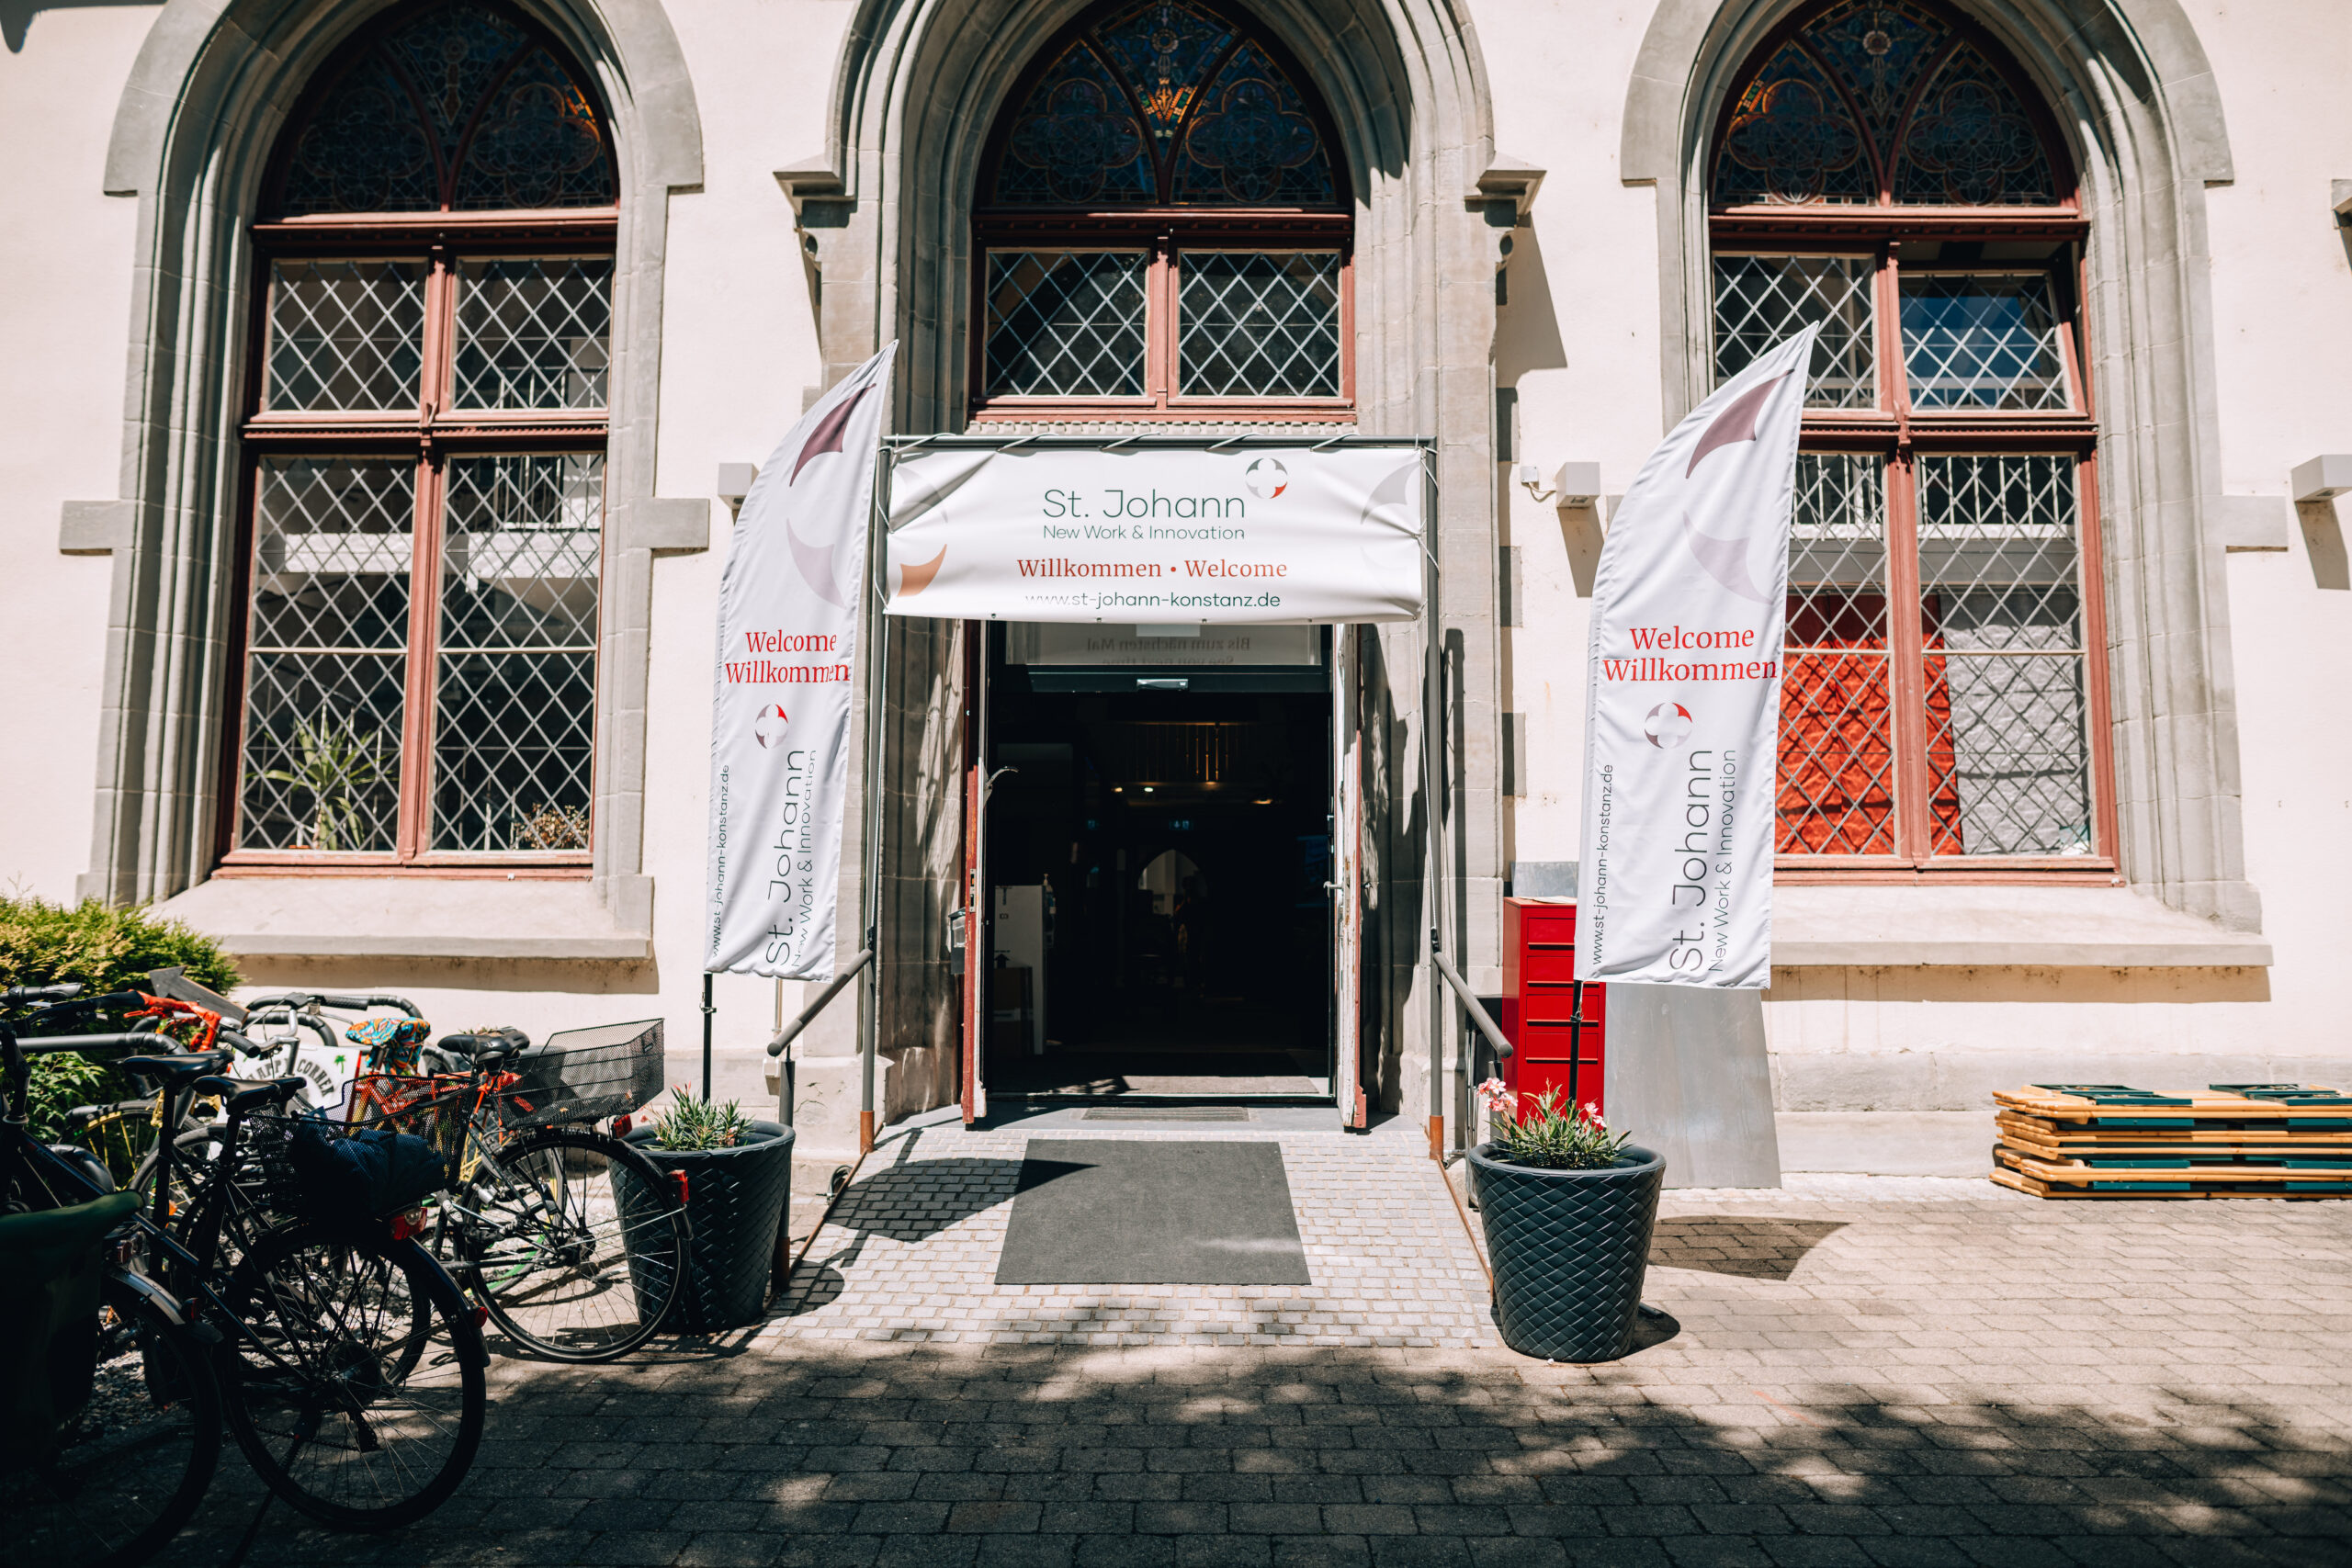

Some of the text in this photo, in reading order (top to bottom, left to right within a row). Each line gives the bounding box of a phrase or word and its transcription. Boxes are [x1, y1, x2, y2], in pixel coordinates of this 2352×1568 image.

[1043, 488, 1245, 519] St. Johann
[1043, 525, 1245, 540] New Work & Innovation
[1017, 558, 1287, 578] Willkommen Welcome
[1025, 592, 1281, 610] www.st-johann-konstanz.de
[745, 629, 837, 653] Welcome
[1630, 626, 1755, 650] Welcome
[725, 660, 850, 683] Willkommen
[1602, 658, 1778, 682] Willkommen
[797, 750, 817, 853] Innovation
[765, 750, 805, 966] St. Johann
[797, 859, 813, 873] &
[1592, 764, 1613, 965] www.st-johann-konstanz.de
[1668, 750, 1713, 972] St. Johann
[1708, 750, 1736, 972] New Work & Innovation
[797, 877, 814, 924] Work
[297, 1058, 334, 1098] CORNER
